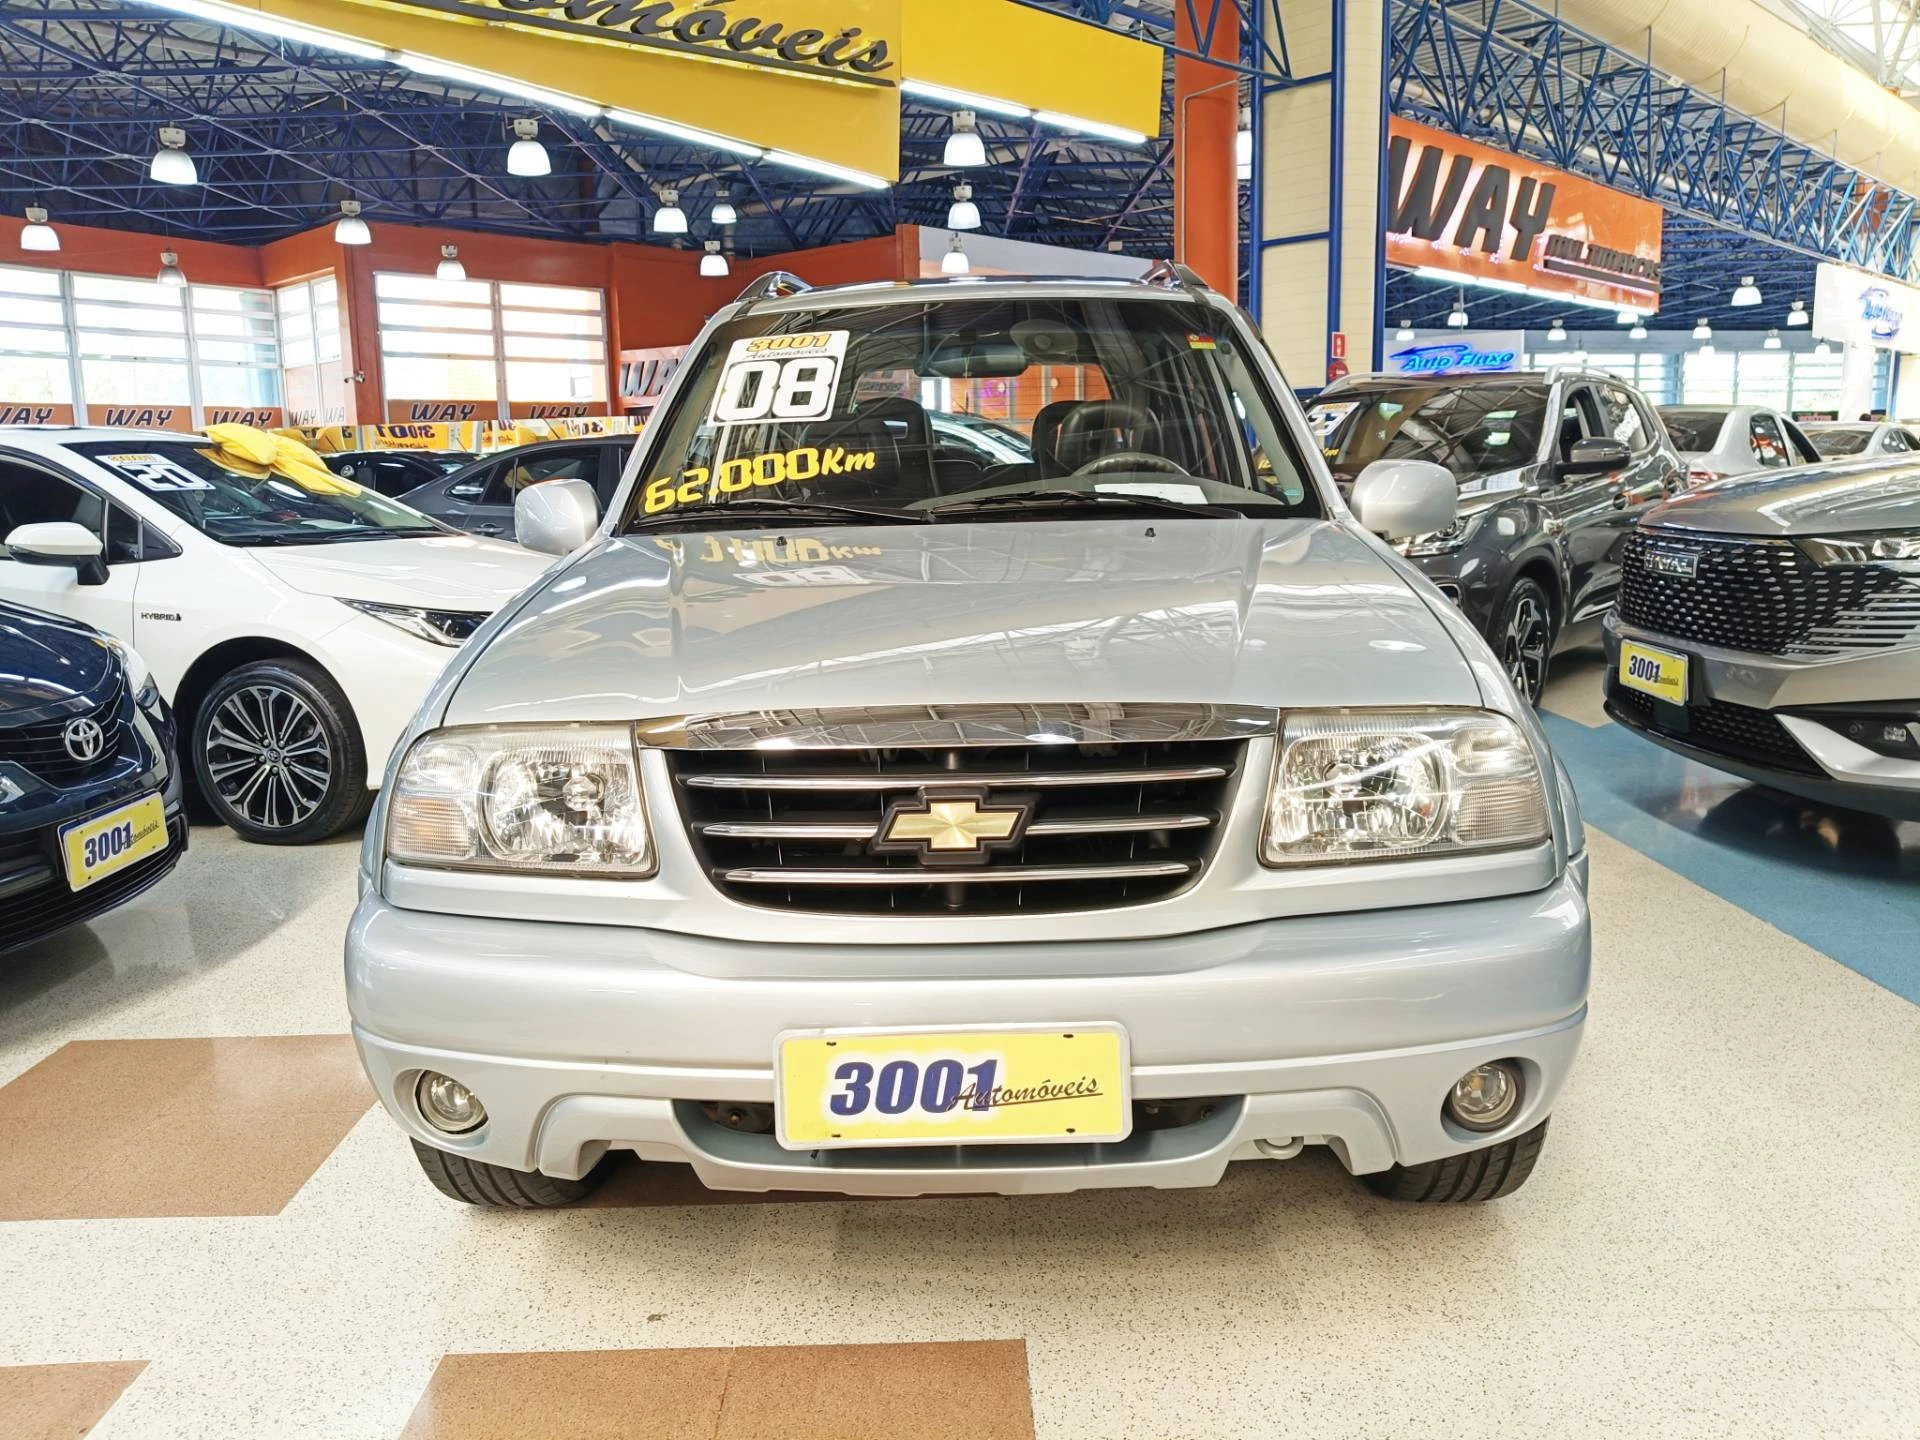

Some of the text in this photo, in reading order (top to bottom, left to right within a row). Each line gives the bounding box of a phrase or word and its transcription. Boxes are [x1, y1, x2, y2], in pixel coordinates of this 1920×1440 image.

[501, 0, 893, 73] móveis
[1388, 135, 1556, 261] WAY
[747, 333, 832, 352] 3001
[1401, 355, 1452, 372] Auto
[716, 356, 837, 421] 08
[105, 409, 174, 426] WAY
[212, 410, 273, 426] WAY
[410, 404, 476, 421] WAY
[644, 447, 876, 513] 62.000Km
[140, 612, 175, 621] HYBRID
[1628, 655, 1661, 683] 3001
[84, 821, 131, 868] 3001
[829, 1058, 998, 1116] 3001
[946, 1075, 1100, 1111] Automóveis
